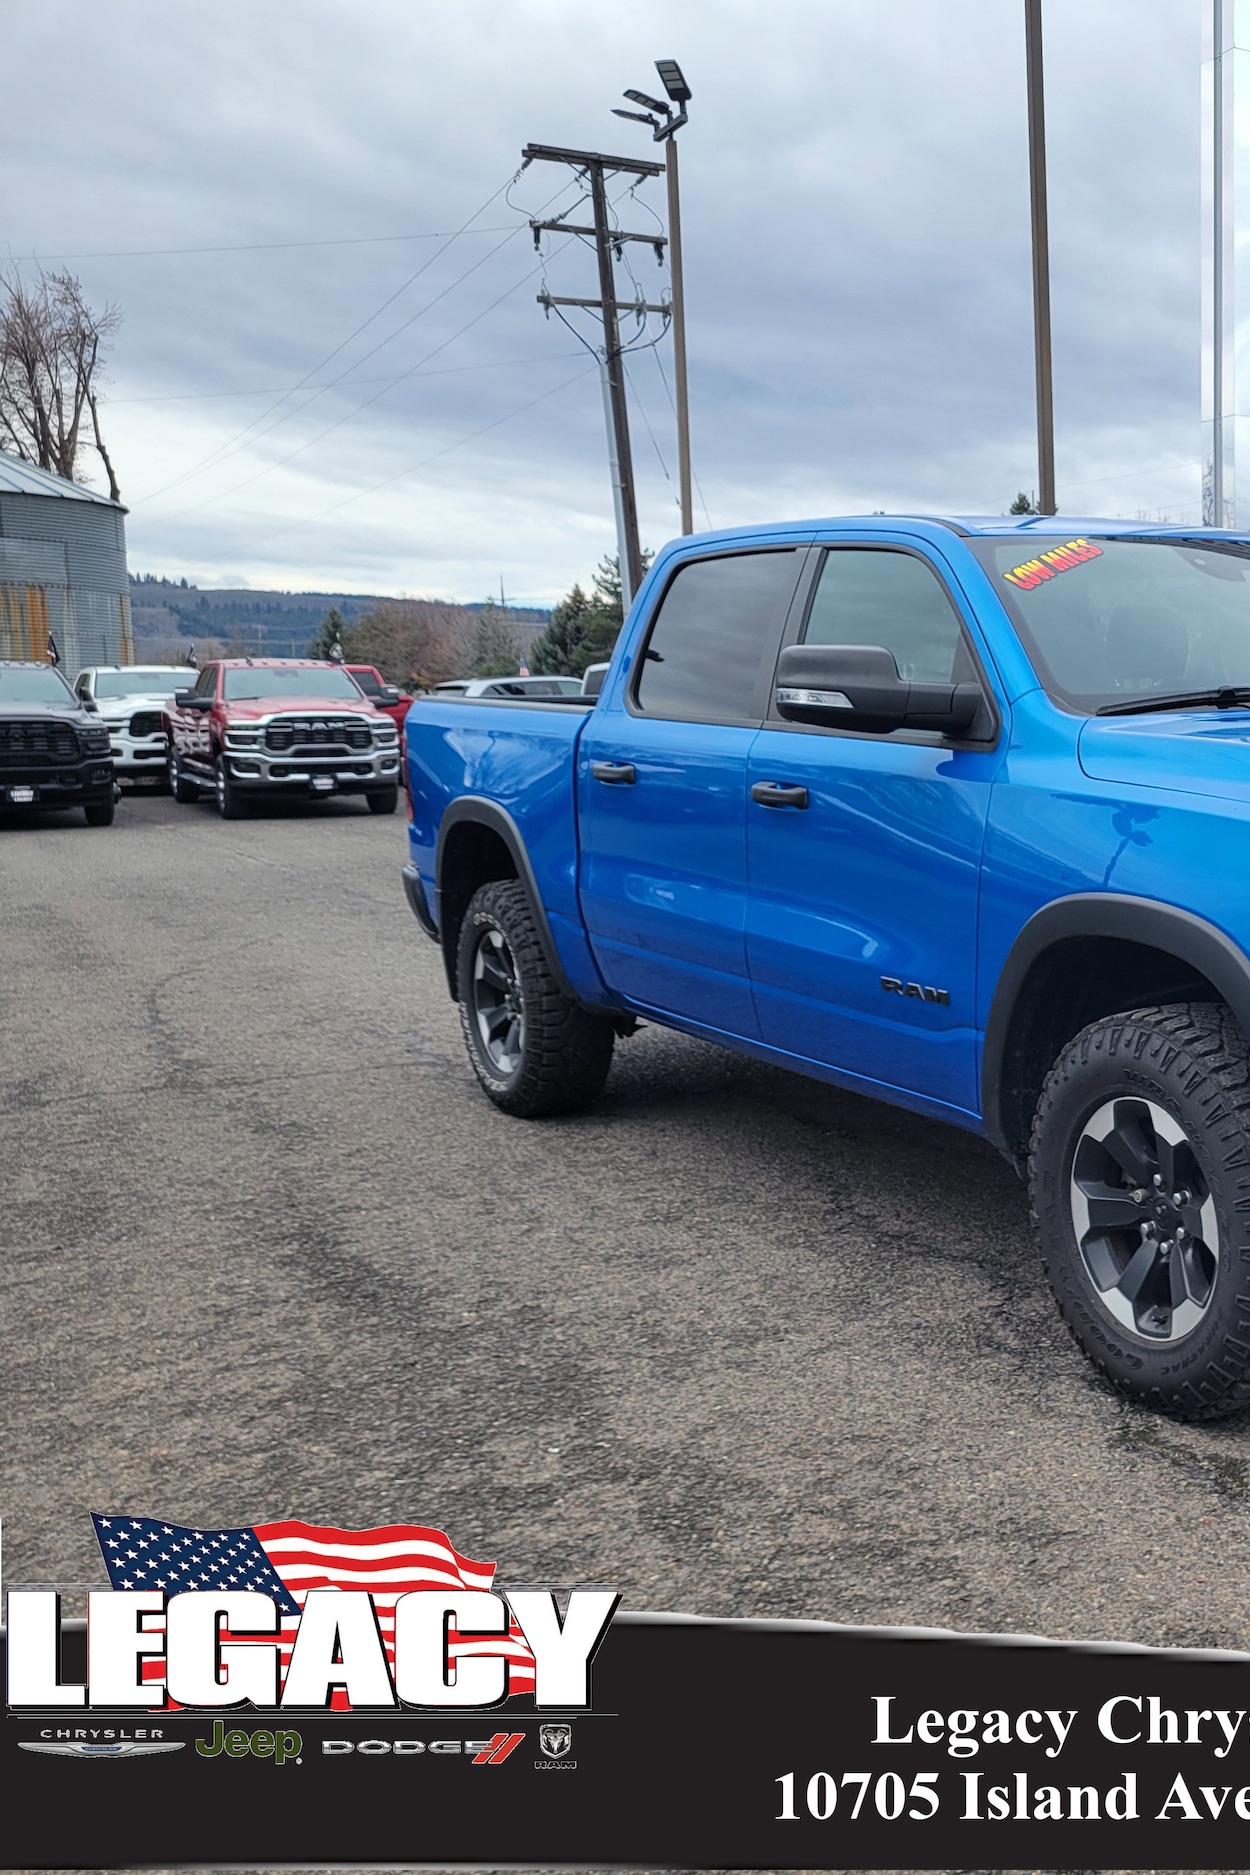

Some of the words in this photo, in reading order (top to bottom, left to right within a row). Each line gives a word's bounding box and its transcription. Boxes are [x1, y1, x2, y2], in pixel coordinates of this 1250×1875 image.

[1003, 559, 1056, 590] LOW
[1039, 538, 1103, 571] MILES
[880, 975, 950, 1007] RAM
